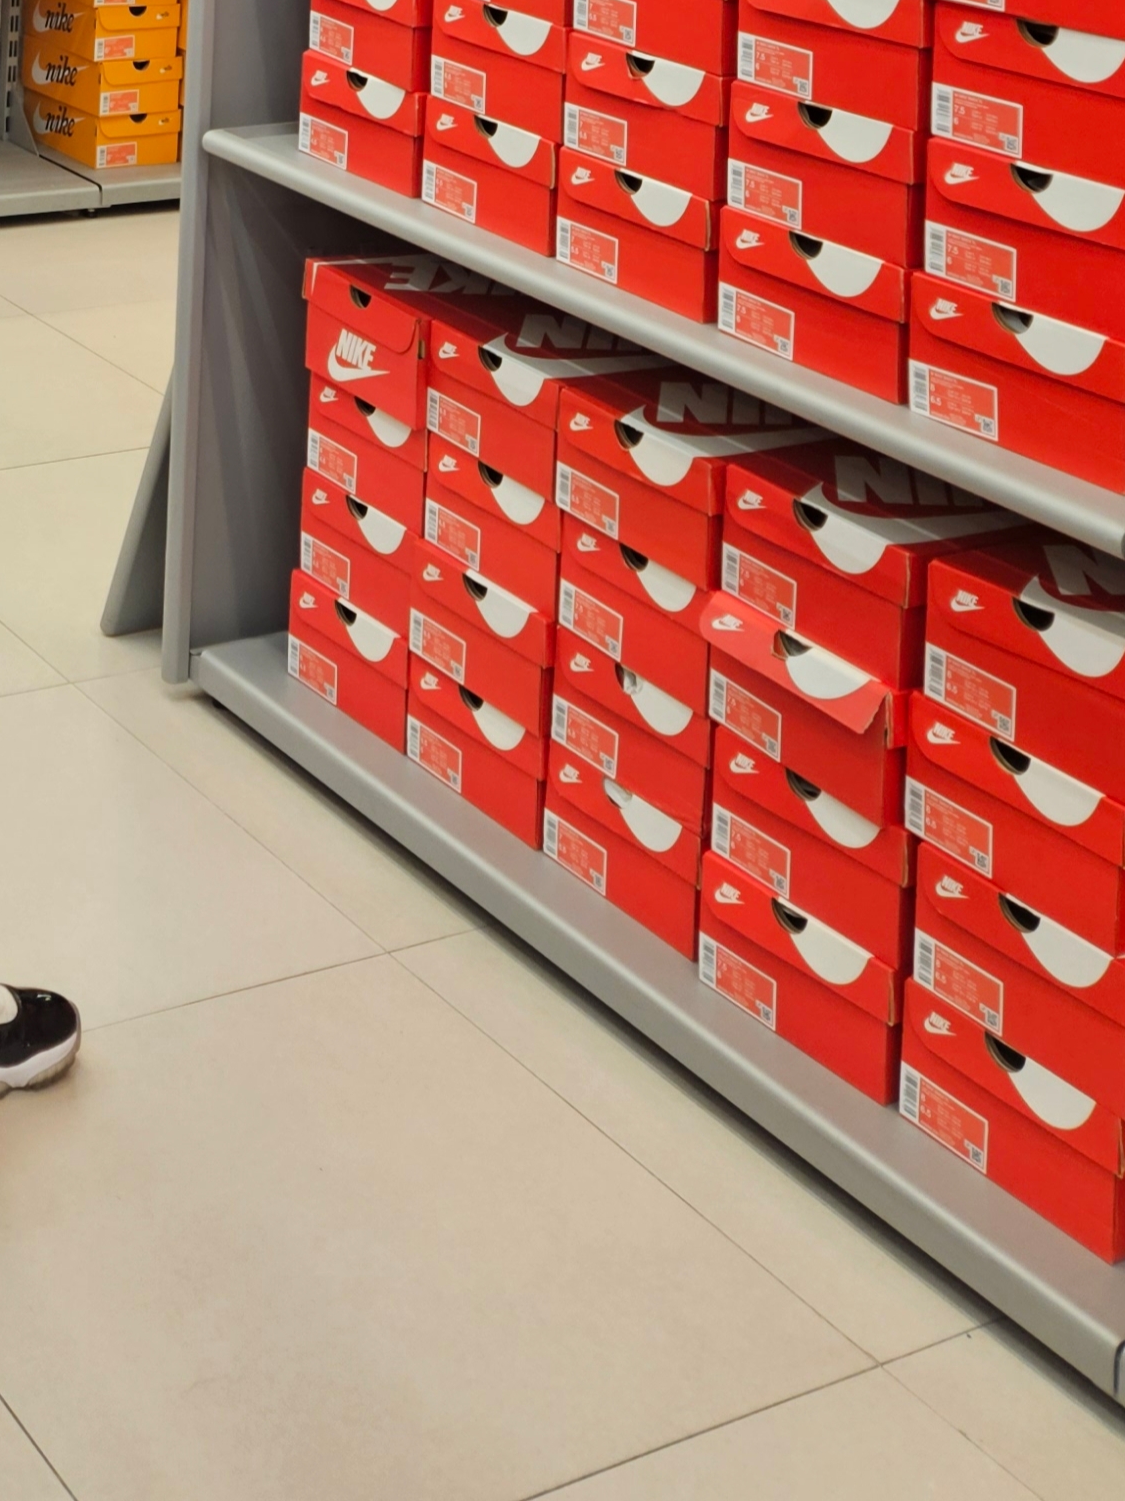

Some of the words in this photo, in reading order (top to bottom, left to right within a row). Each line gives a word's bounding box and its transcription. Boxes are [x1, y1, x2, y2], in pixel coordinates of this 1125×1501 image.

[45, 2, 75, 33] nike
[46, 55, 77, 87] nike
[45, 105, 76, 137] nike
[335, 328, 377, 371] NIKE
